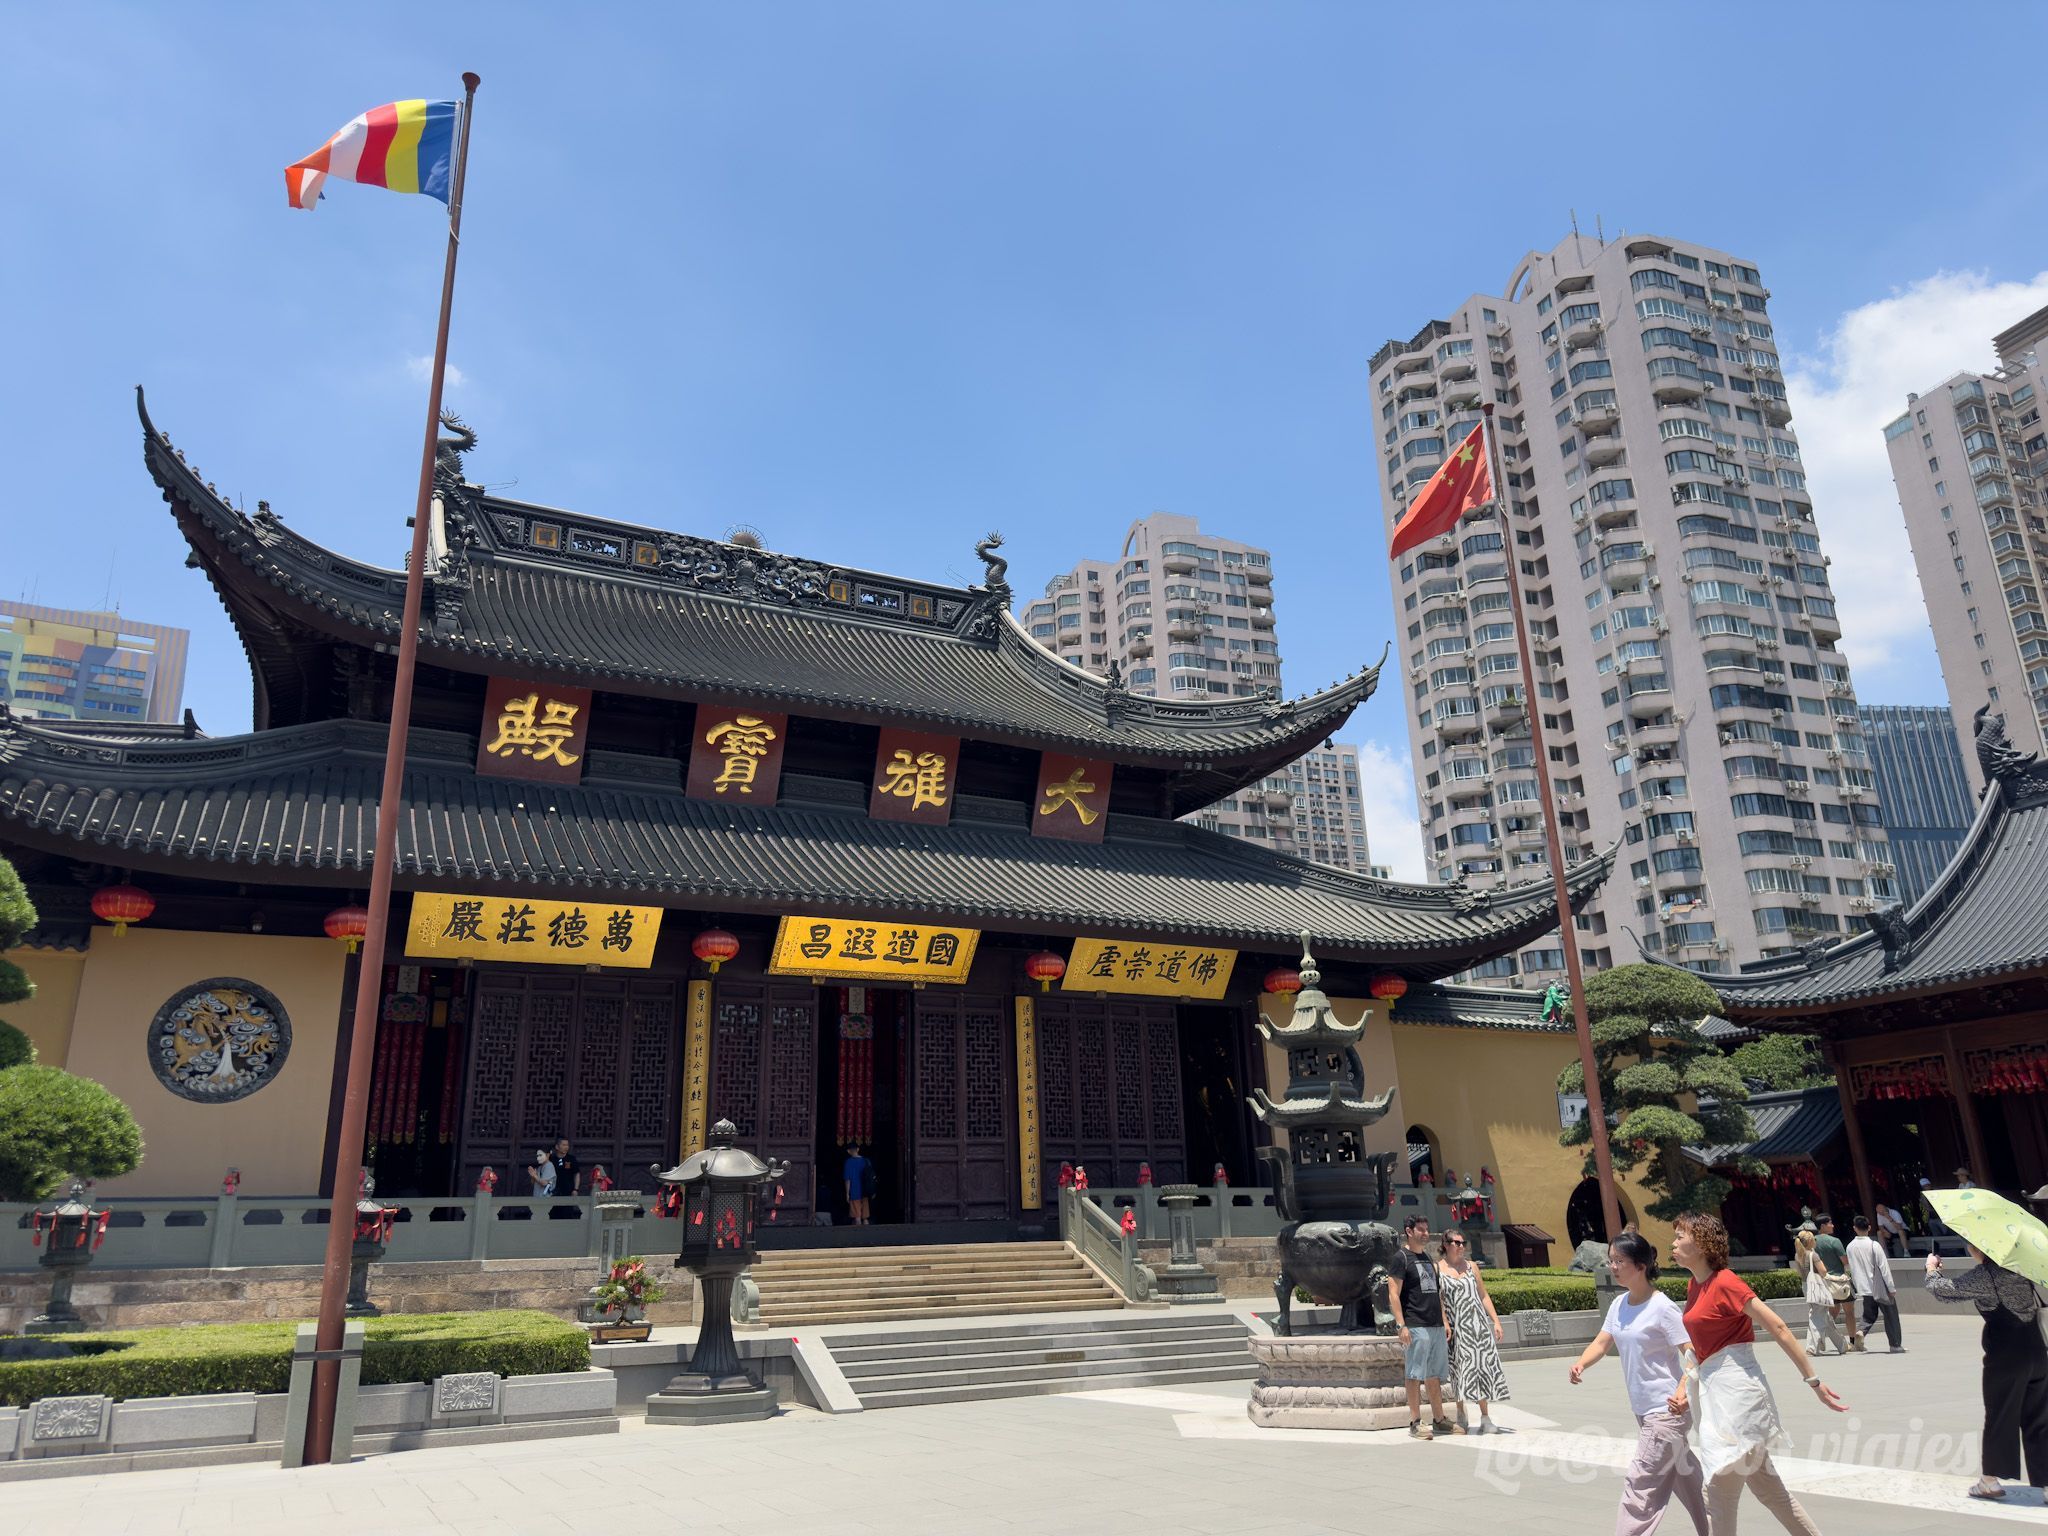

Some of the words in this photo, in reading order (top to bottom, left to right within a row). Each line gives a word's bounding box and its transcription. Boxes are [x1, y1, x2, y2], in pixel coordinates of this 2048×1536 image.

[486, 692, 580, 767] 殿
[705, 713, 777, 794] 寶
[878, 749, 948, 812] 雄
[1039, 767, 1099, 826] 大
